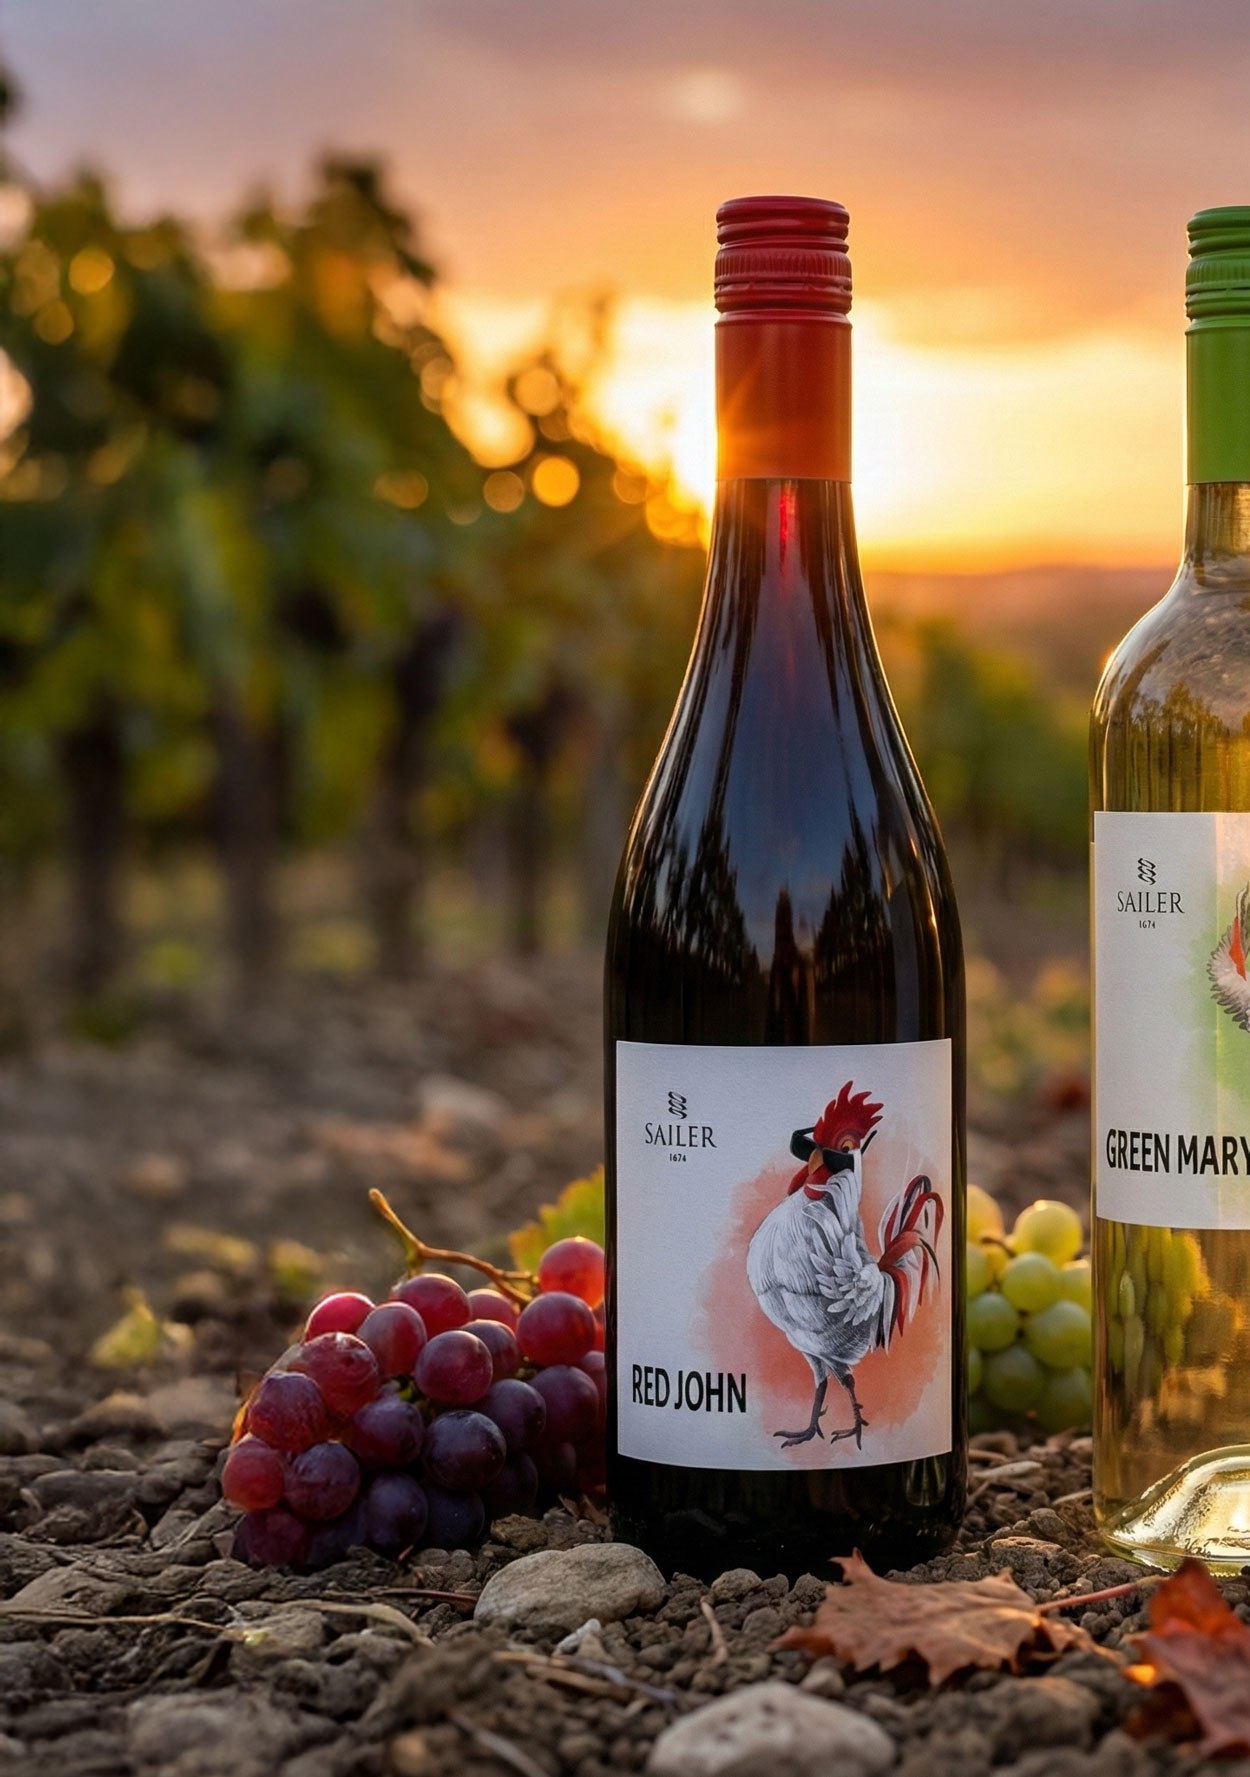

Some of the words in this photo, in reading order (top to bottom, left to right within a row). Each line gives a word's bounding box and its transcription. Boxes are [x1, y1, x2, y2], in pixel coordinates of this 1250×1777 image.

[1117, 890, 1185, 914] SAILER
[645, 1122, 717, 1148] SAILER
[669, 1153, 687, 1162] 1674
[1106, 1128, 1170, 1174] GREEN
[632, 1363, 671, 1408] RED
[673, 1370, 747, 1414] JOHN
